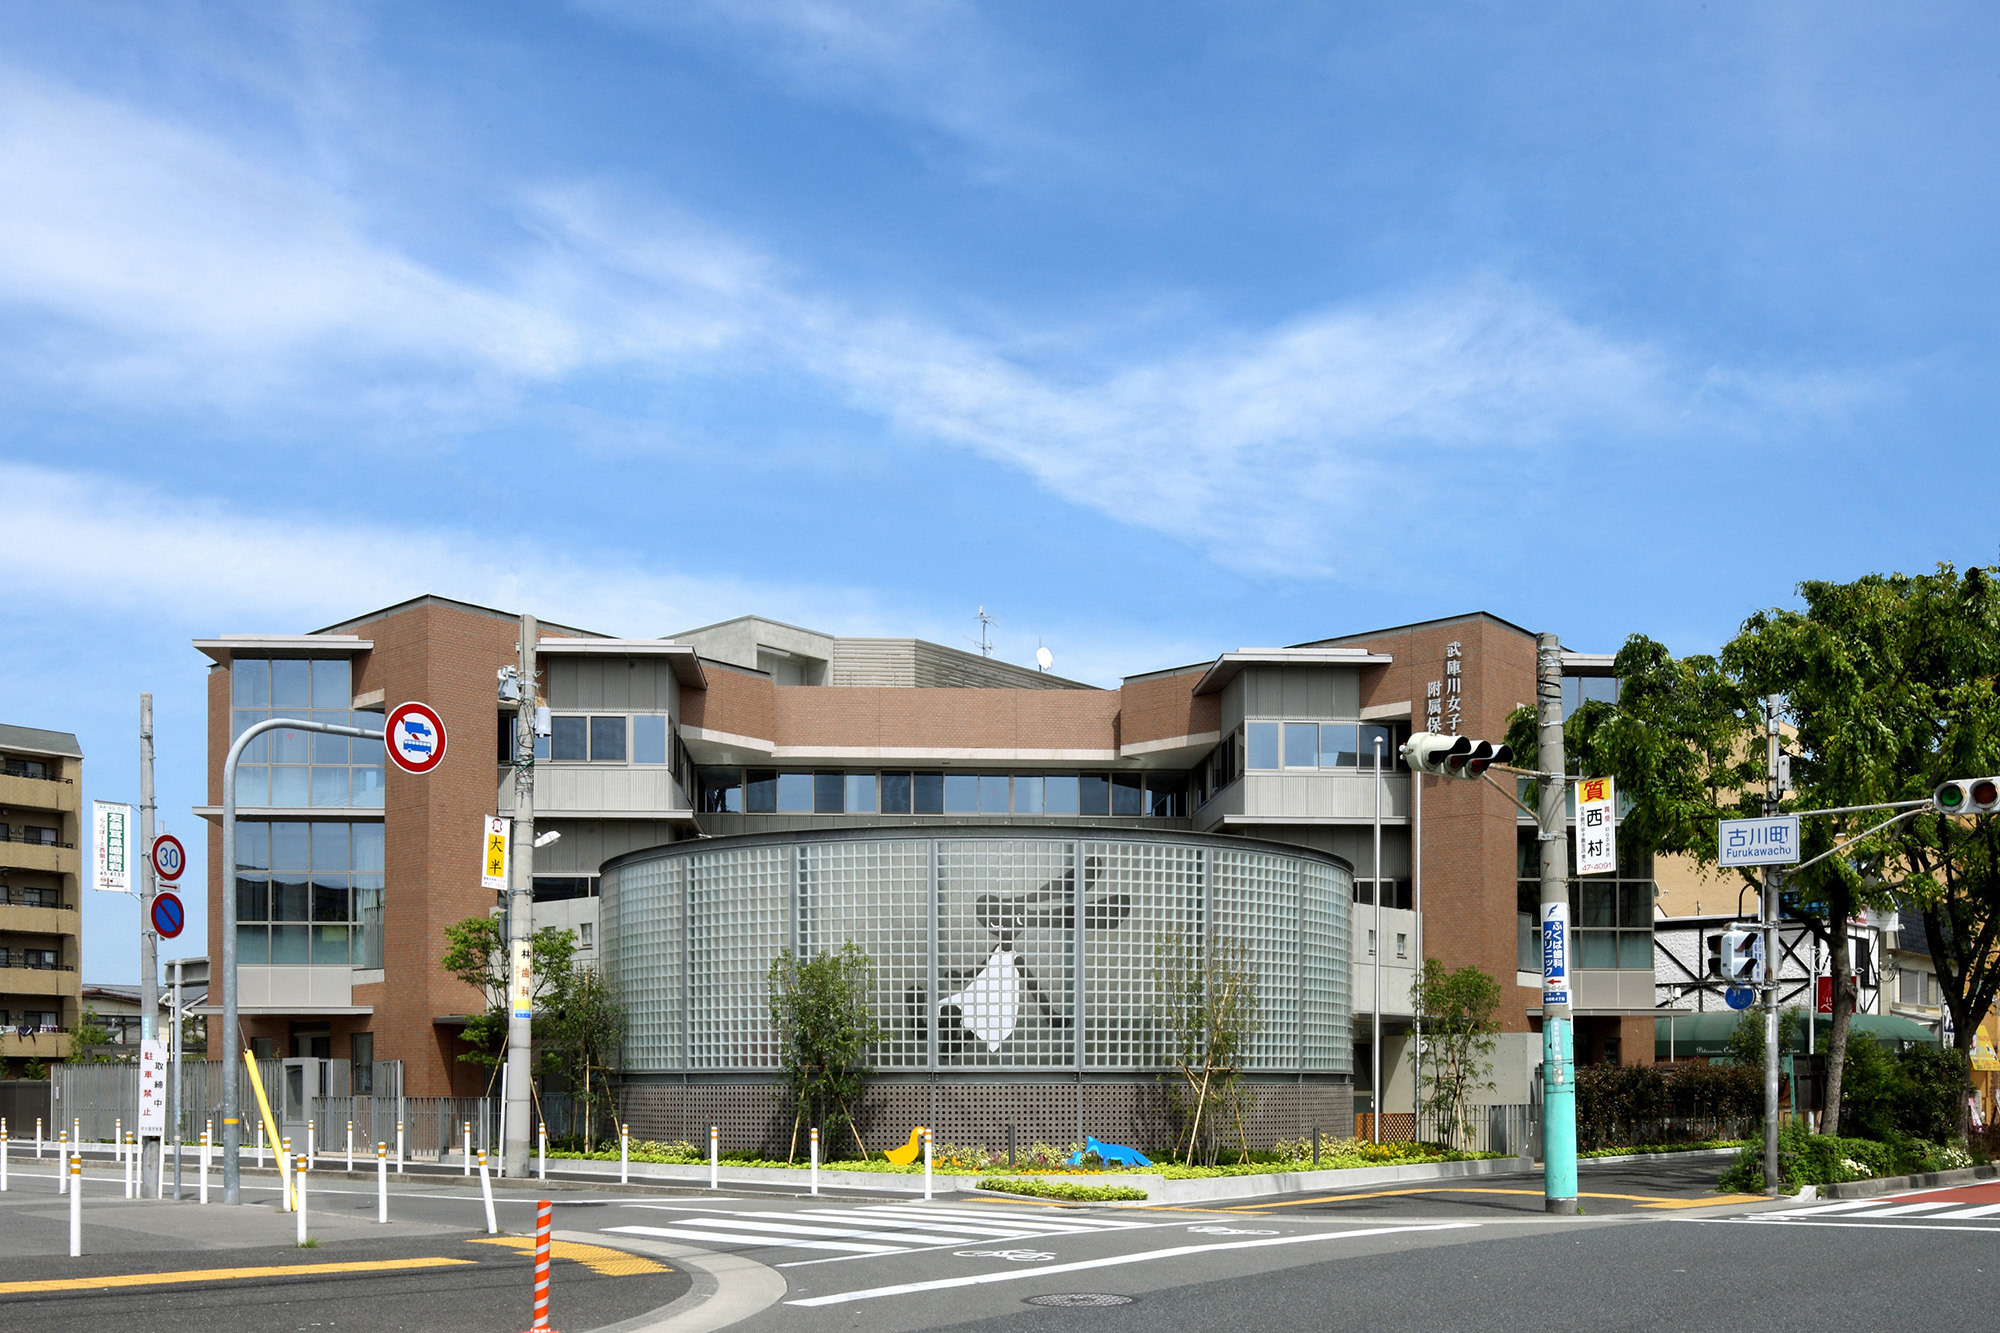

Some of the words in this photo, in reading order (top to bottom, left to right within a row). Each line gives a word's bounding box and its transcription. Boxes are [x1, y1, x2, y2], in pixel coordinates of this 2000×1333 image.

[1584, 779, 1604, 802] 質
[1586, 808, 1603, 857] 西村
[1726, 845, 1791, 858] Furukawacho
[1728, 826, 1789, 847] 古川町
[160, 847, 178, 869] 30
[489, 836, 503, 875] 大半
[1581, 862, 1612, 871] 47-4091
[1544, 930, 1553, 977] クリニック
[1552, 921, 1563, 968] ふくば歯科
[142, 1051, 153, 1116] 駐車禁止
[154, 1062, 164, 1108] 取締中
